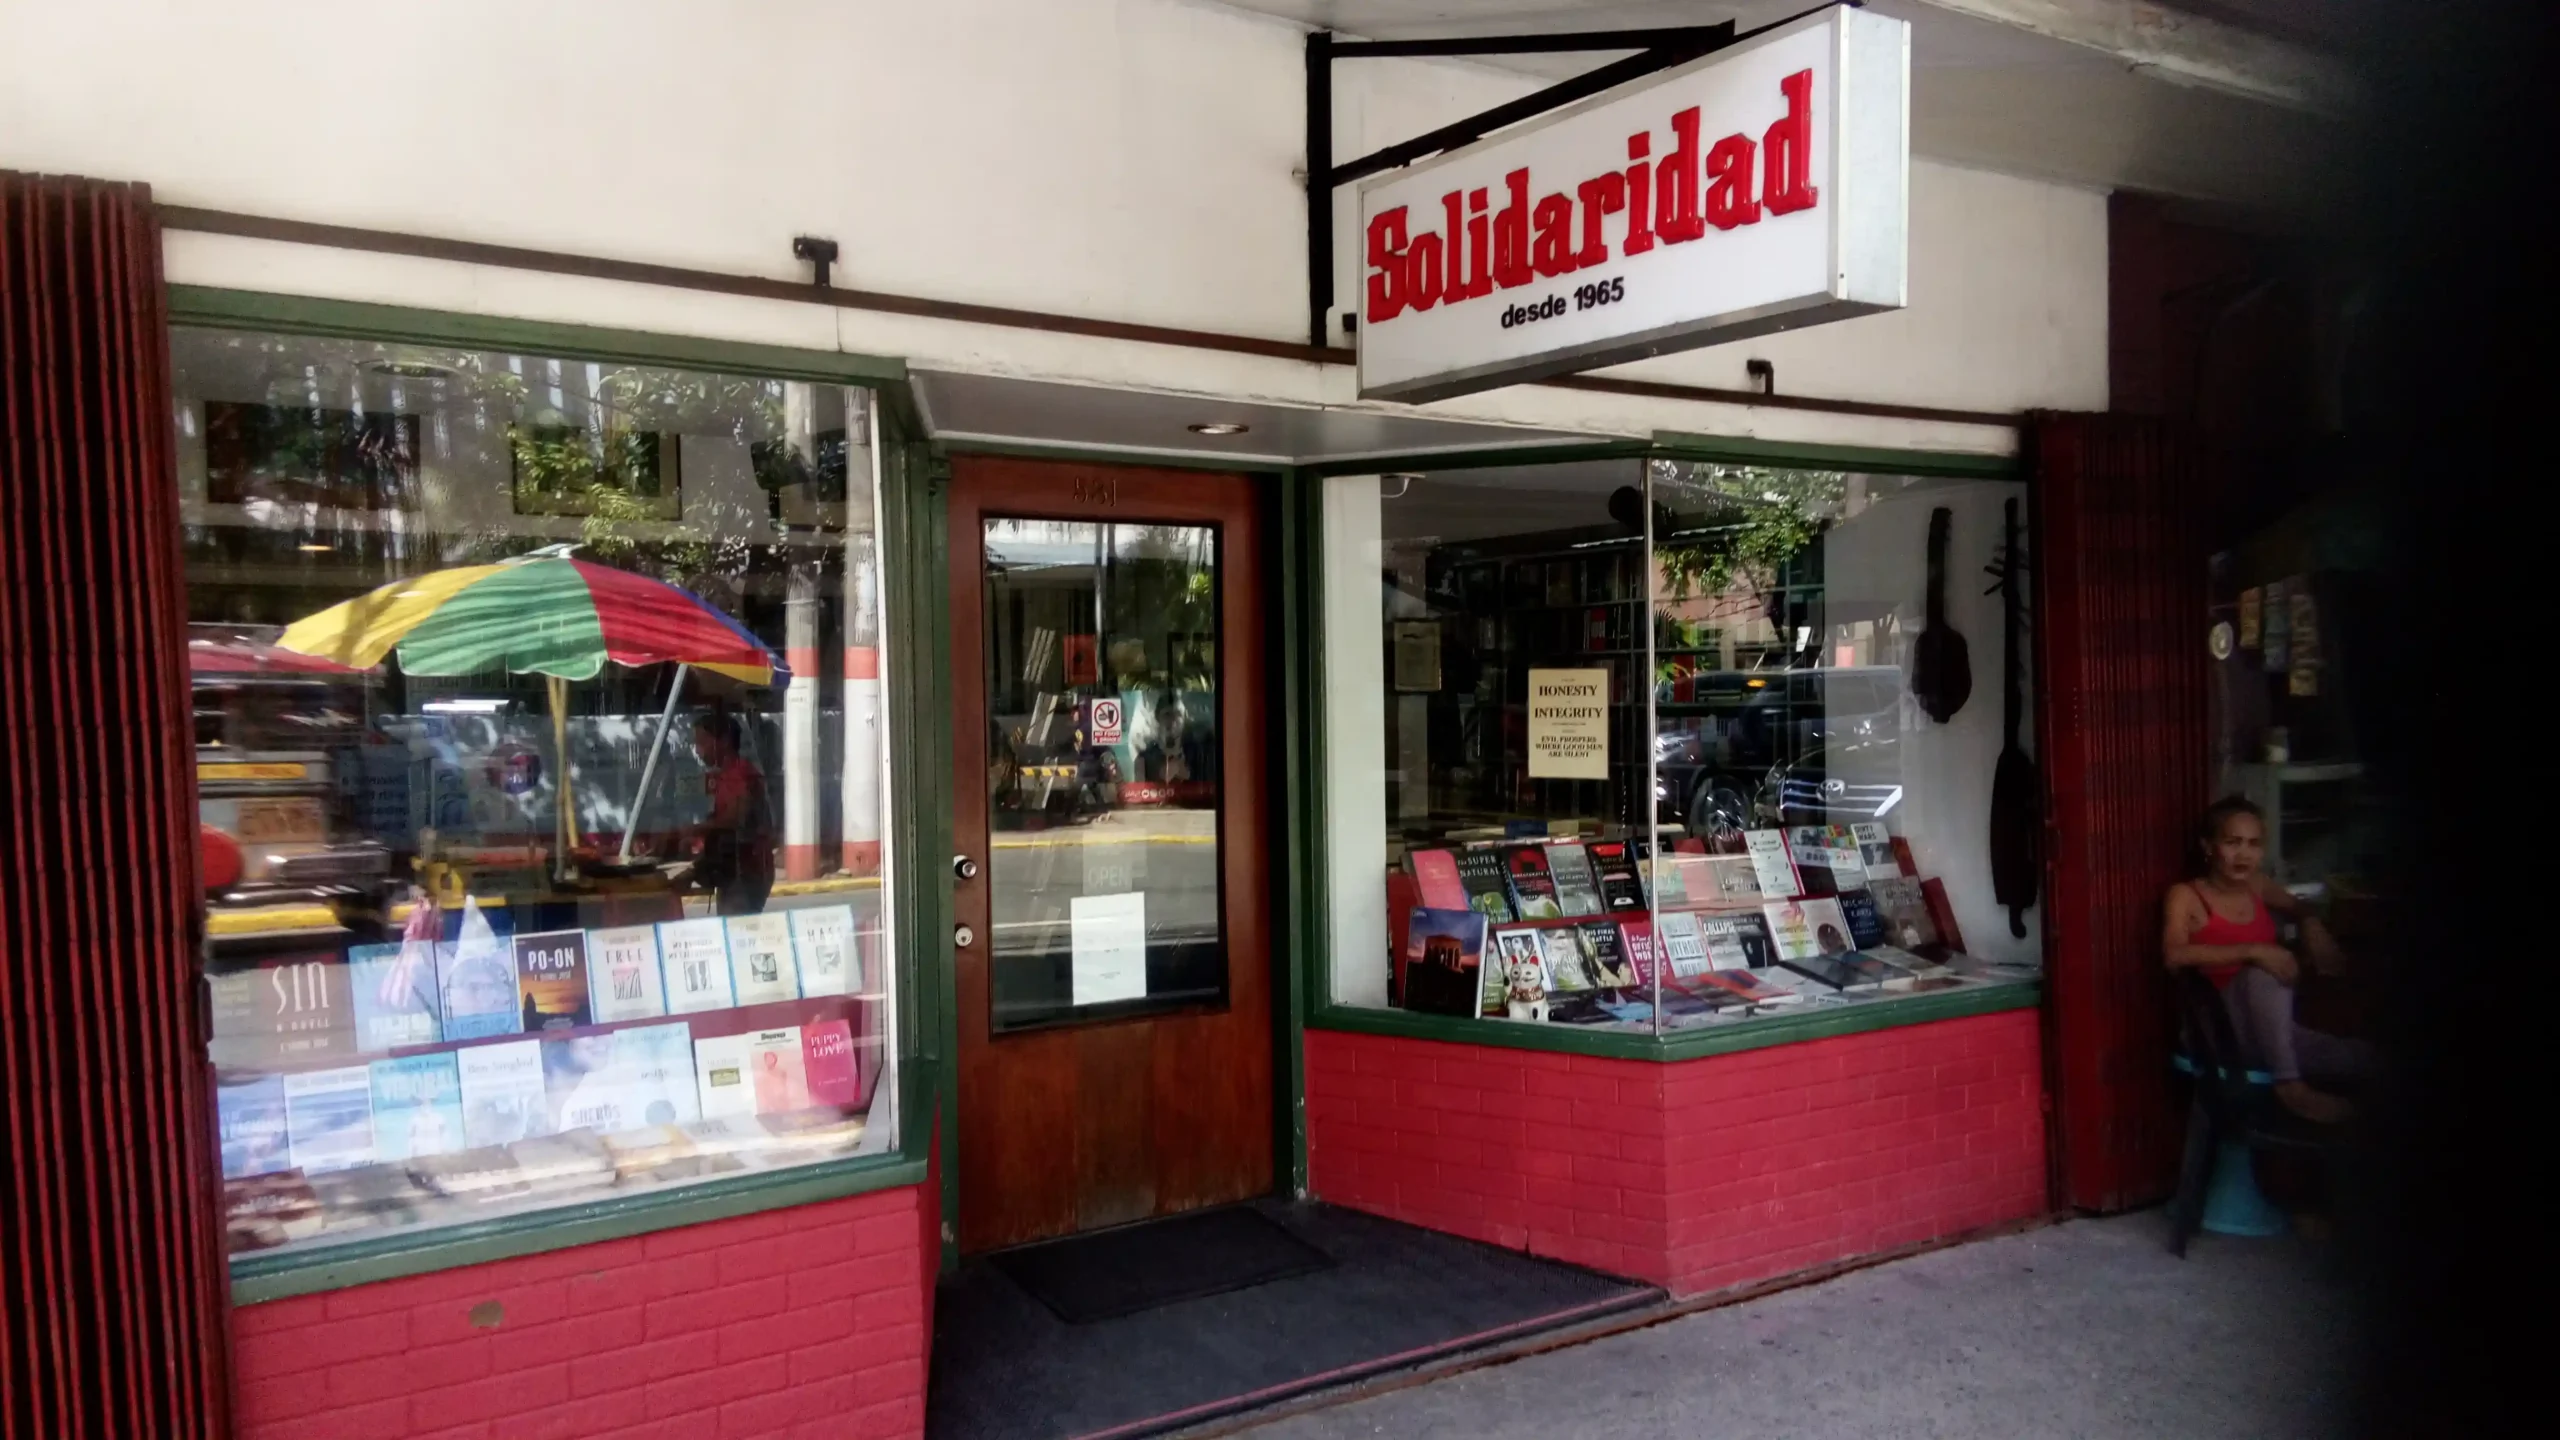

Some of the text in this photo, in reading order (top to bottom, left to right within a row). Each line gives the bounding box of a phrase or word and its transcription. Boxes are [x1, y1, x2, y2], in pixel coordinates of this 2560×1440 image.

[1366, 67, 1819, 324] Solidaridad
[1500, 277, 1625, 329] desde 1965
[1539, 684, 1598, 697] HONESTY
[1534, 706, 1604, 719] INTEGRITY
[1541, 735, 1559, 743] EVIL
[1563, 743, 1585, 751] GOOD
[1467, 854, 1497, 865] SUPER
[1087, 865, 1131, 887] OPEN
[1459, 866, 1500, 879] NATURAL
[1591, 935, 1614, 944] BATTLE
[528, 946, 575, 972] PO-ON
[272, 962, 331, 1015] SIN
[811, 1032, 841, 1047] PUPPY
[812, 1043, 845, 1059] LOVE
